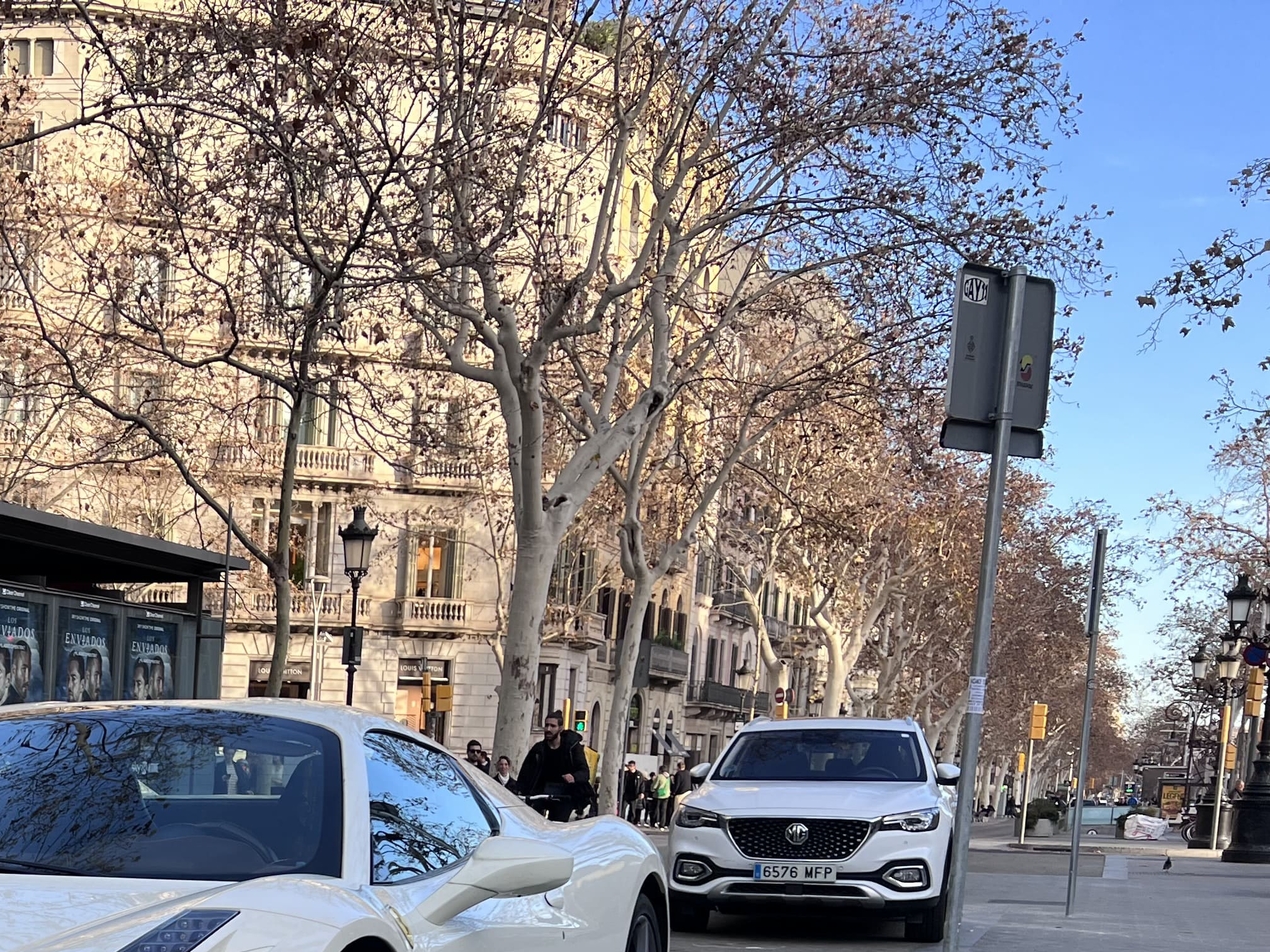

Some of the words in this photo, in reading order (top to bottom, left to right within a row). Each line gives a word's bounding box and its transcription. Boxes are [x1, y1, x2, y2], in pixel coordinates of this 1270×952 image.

[788, 825, 806, 842] MG
[763, 866, 798, 879] 6576
[804, 866, 833, 879] MFP
